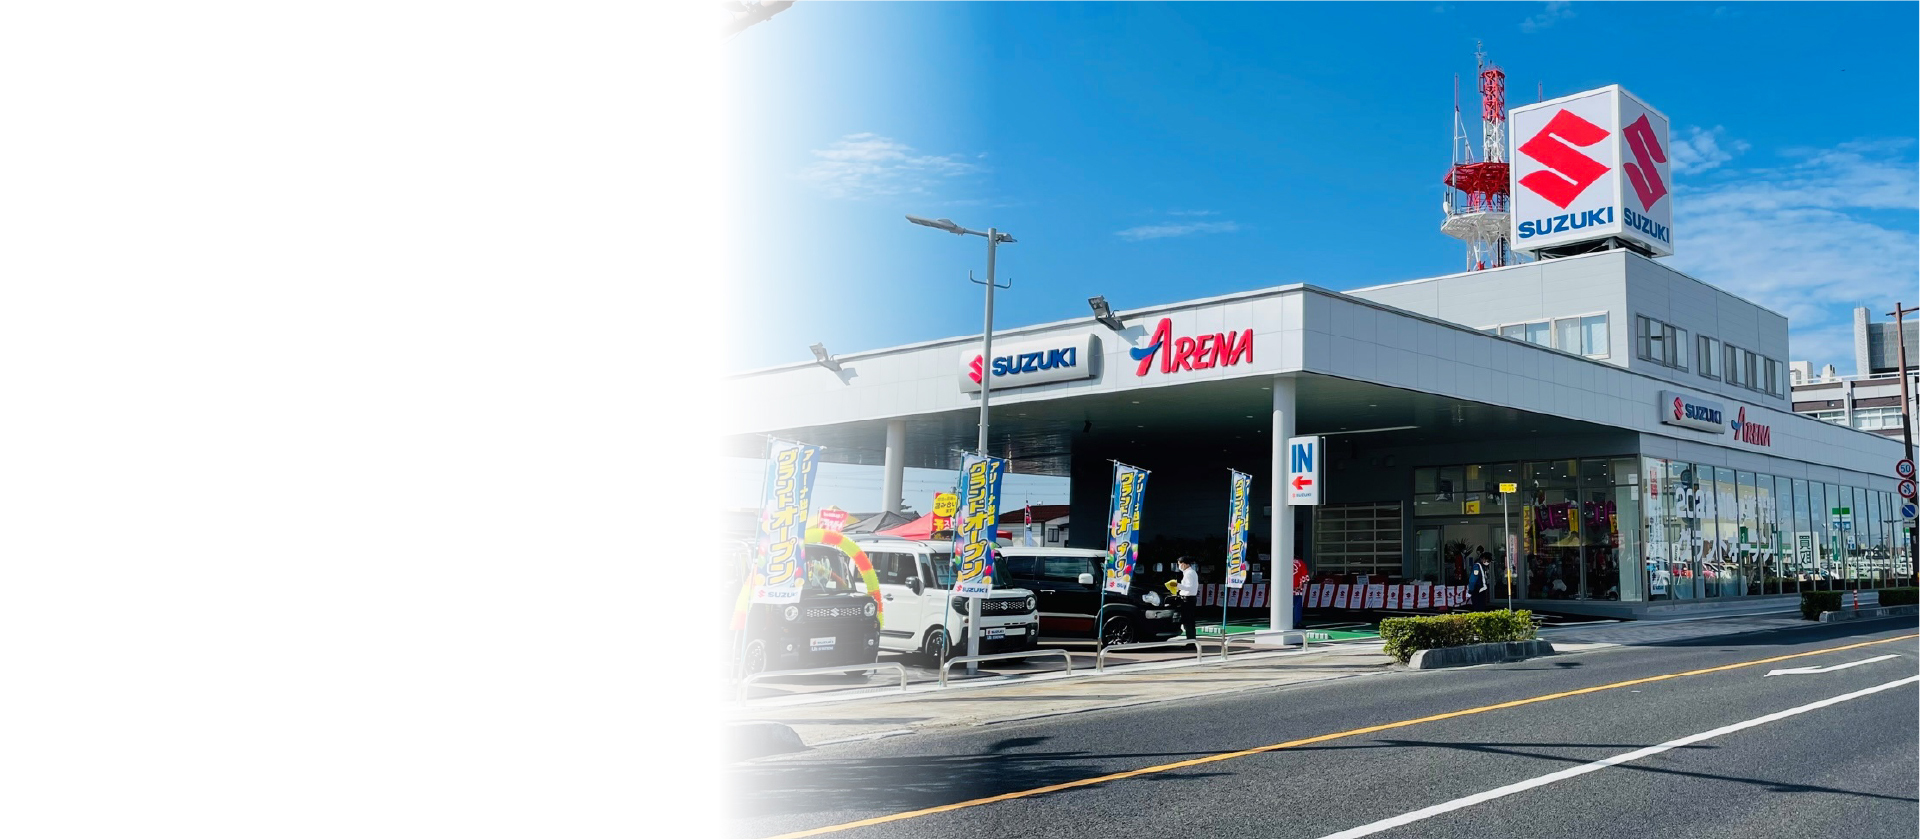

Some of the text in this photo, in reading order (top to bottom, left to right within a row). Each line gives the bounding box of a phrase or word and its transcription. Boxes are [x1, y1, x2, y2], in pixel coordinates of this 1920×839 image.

[1518, 206, 1614, 239] SUZUKI
[1623, 207, 1670, 244] SUZUKI
[992, 346, 1077, 376] SUZUKI
[1129, 317, 1254, 377] ARENA
[1685, 403, 1722, 425] SUZUKI
[1731, 406, 1771, 447] ARENA
[1291, 443, 1313, 473] IN
[1900, 464, 1911, 473] 50
[768, 447, 799, 587] グランドオープン
[963, 460, 987, 582] グランドオープン
